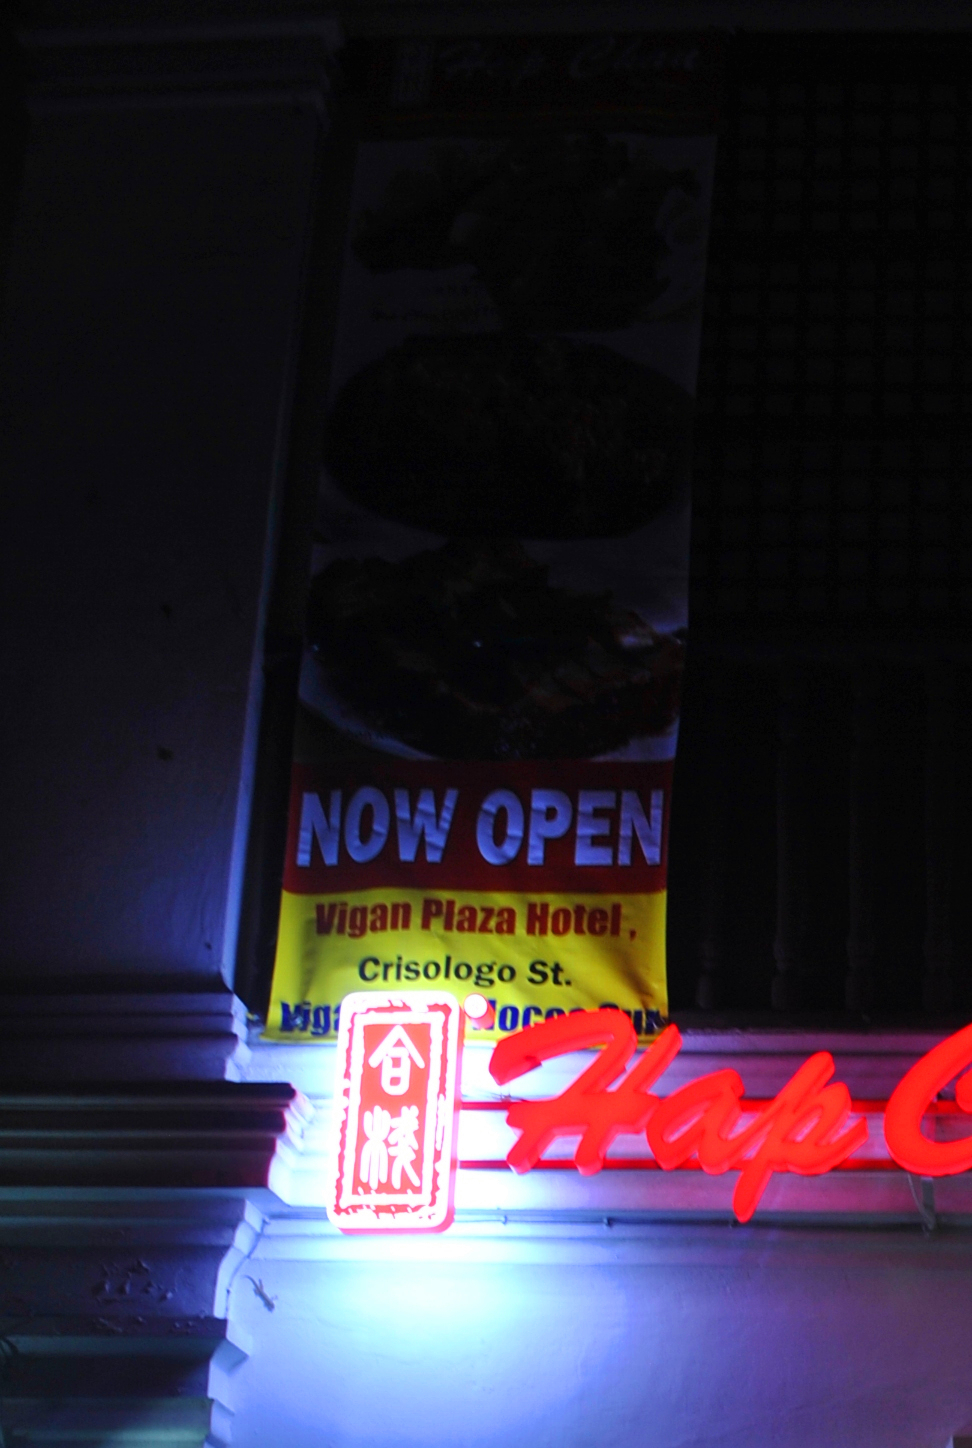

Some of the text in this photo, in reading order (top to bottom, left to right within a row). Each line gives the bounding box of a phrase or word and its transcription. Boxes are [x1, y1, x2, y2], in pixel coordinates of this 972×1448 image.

[296, 786, 664, 867] NOW OPEN
[315, 901, 411, 939] Vigan
[421, 898, 517, 935] Plaza
[358, 955, 573, 987] Crisologo St.
[488, 1006, 869, 1223] Hap
